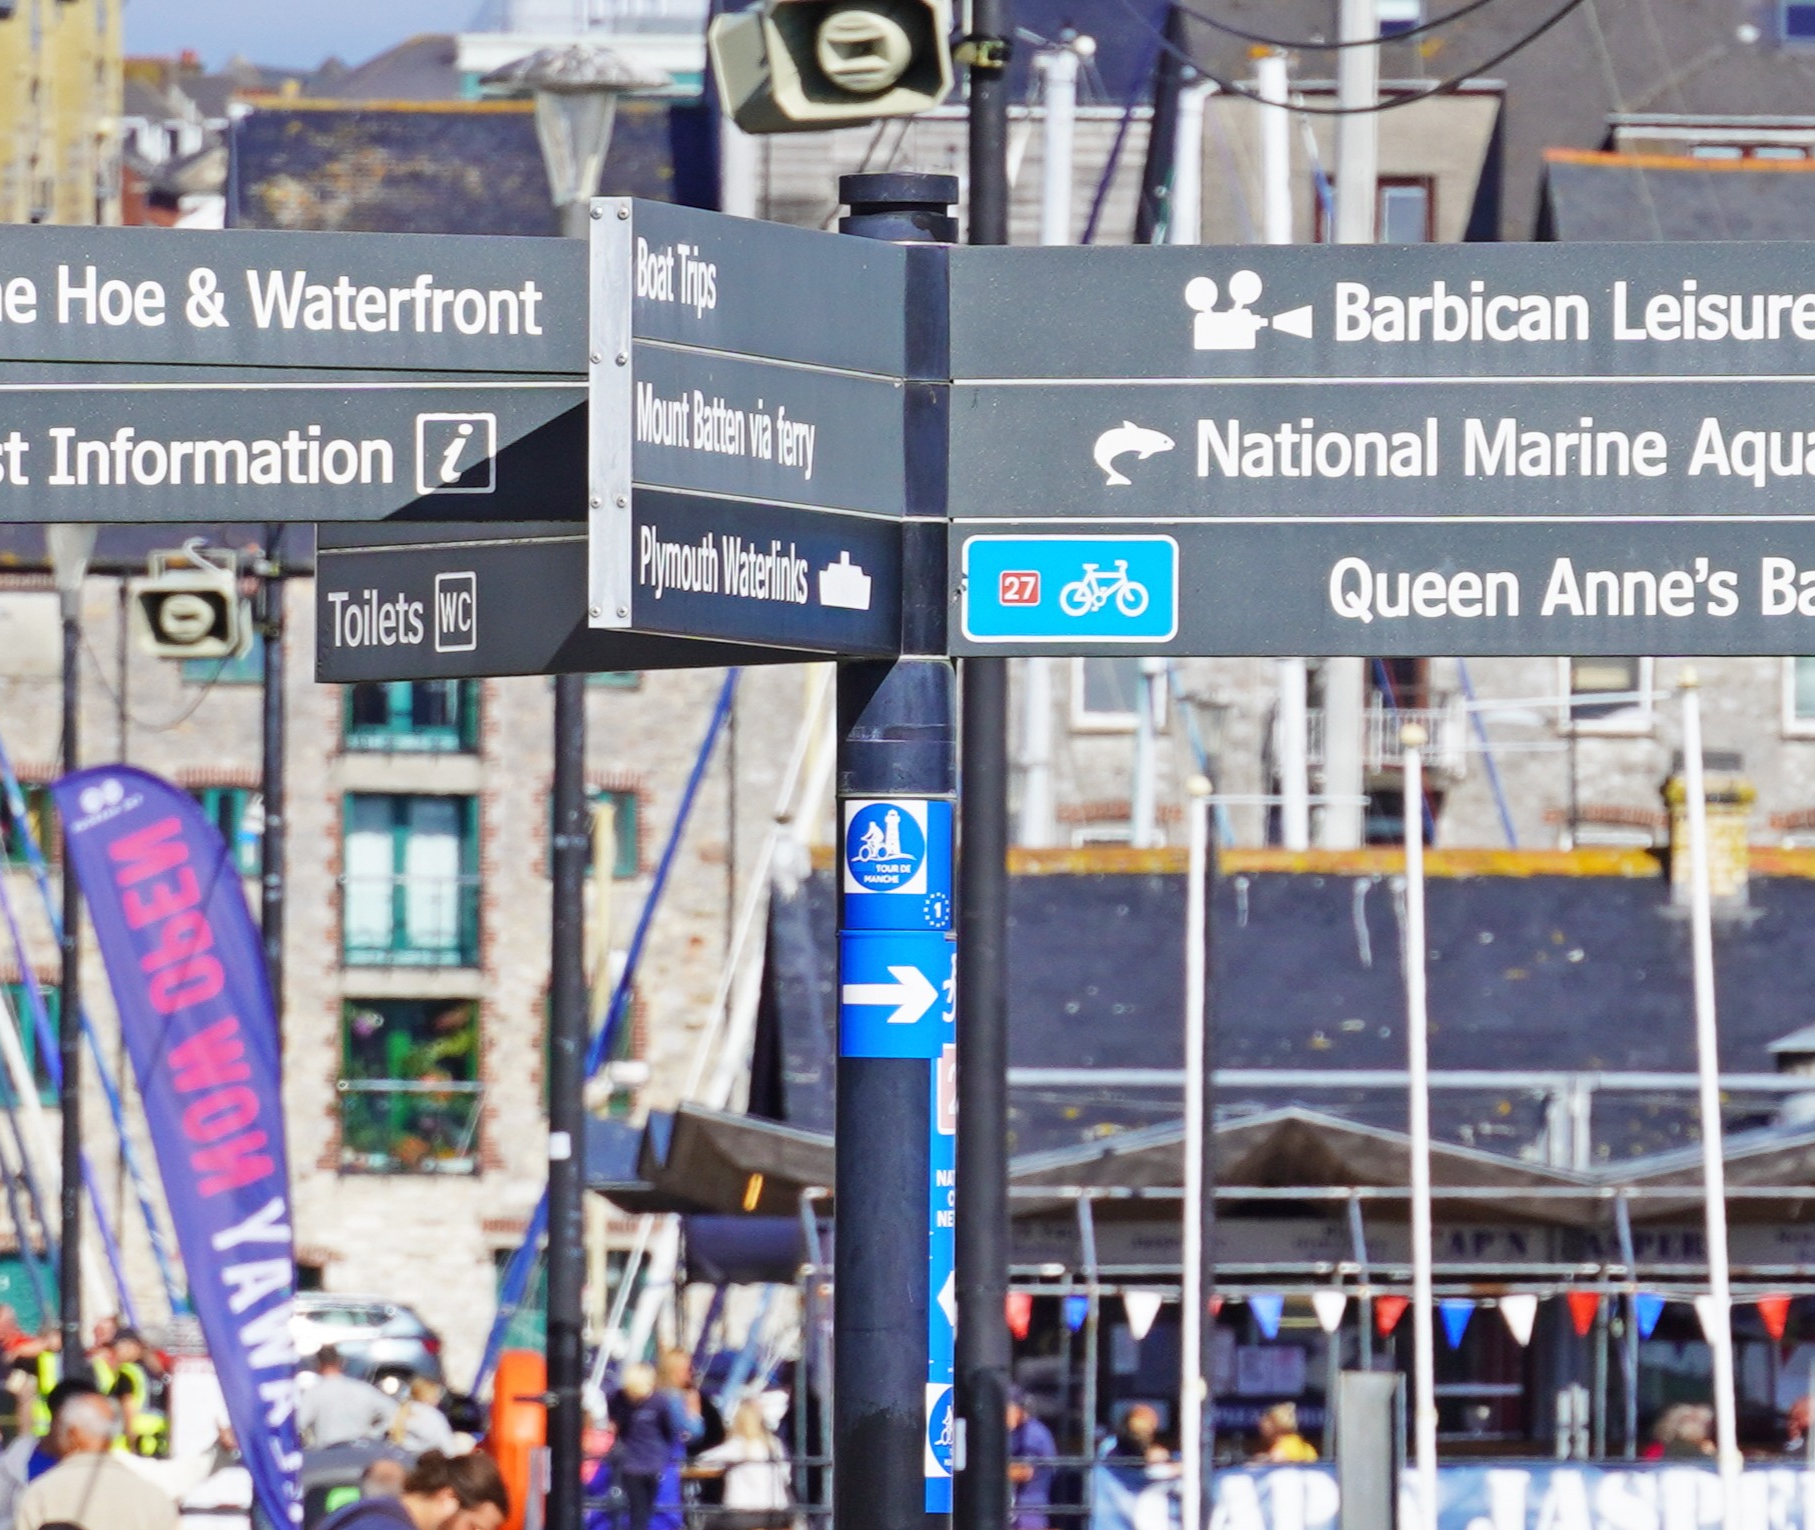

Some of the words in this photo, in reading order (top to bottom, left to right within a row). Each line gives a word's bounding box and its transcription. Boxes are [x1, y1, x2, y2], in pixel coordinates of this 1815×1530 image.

[58, 264, 166, 326] Hoe
[186, 266, 230, 329] &
[247, 268, 544, 336] Waterfront
[637, 236, 674, 303] Boat
[678, 243, 716, 319] Trips
[1335, 279, 1589, 343] Barbican
[48, 424, 393, 486] Information
[636, 381, 690, 448] Mount
[693, 389, 745, 457] Batten
[749, 398, 772, 461] via
[777, 405, 815, 481] ferry
[1197, 417, 1438, 479] National
[1463, 417, 1667, 478] Marine
[640, 524, 718, 599] Plymouth
[723, 535, 808, 604] Waterlinks
[1003, 572, 1037, 602] 27
[1328, 558, 1520, 625] Queen
[1541, 556, 1740, 618] Anne's
[328, 591, 424, 647] Toilets
[439, 593, 472, 634] WC
[864, 875, 899, 884] MANCHE
[876, 864, 899, 873] TOUR
[900, 864, 911, 873] DE
[934, 902, 942, 918] 1
